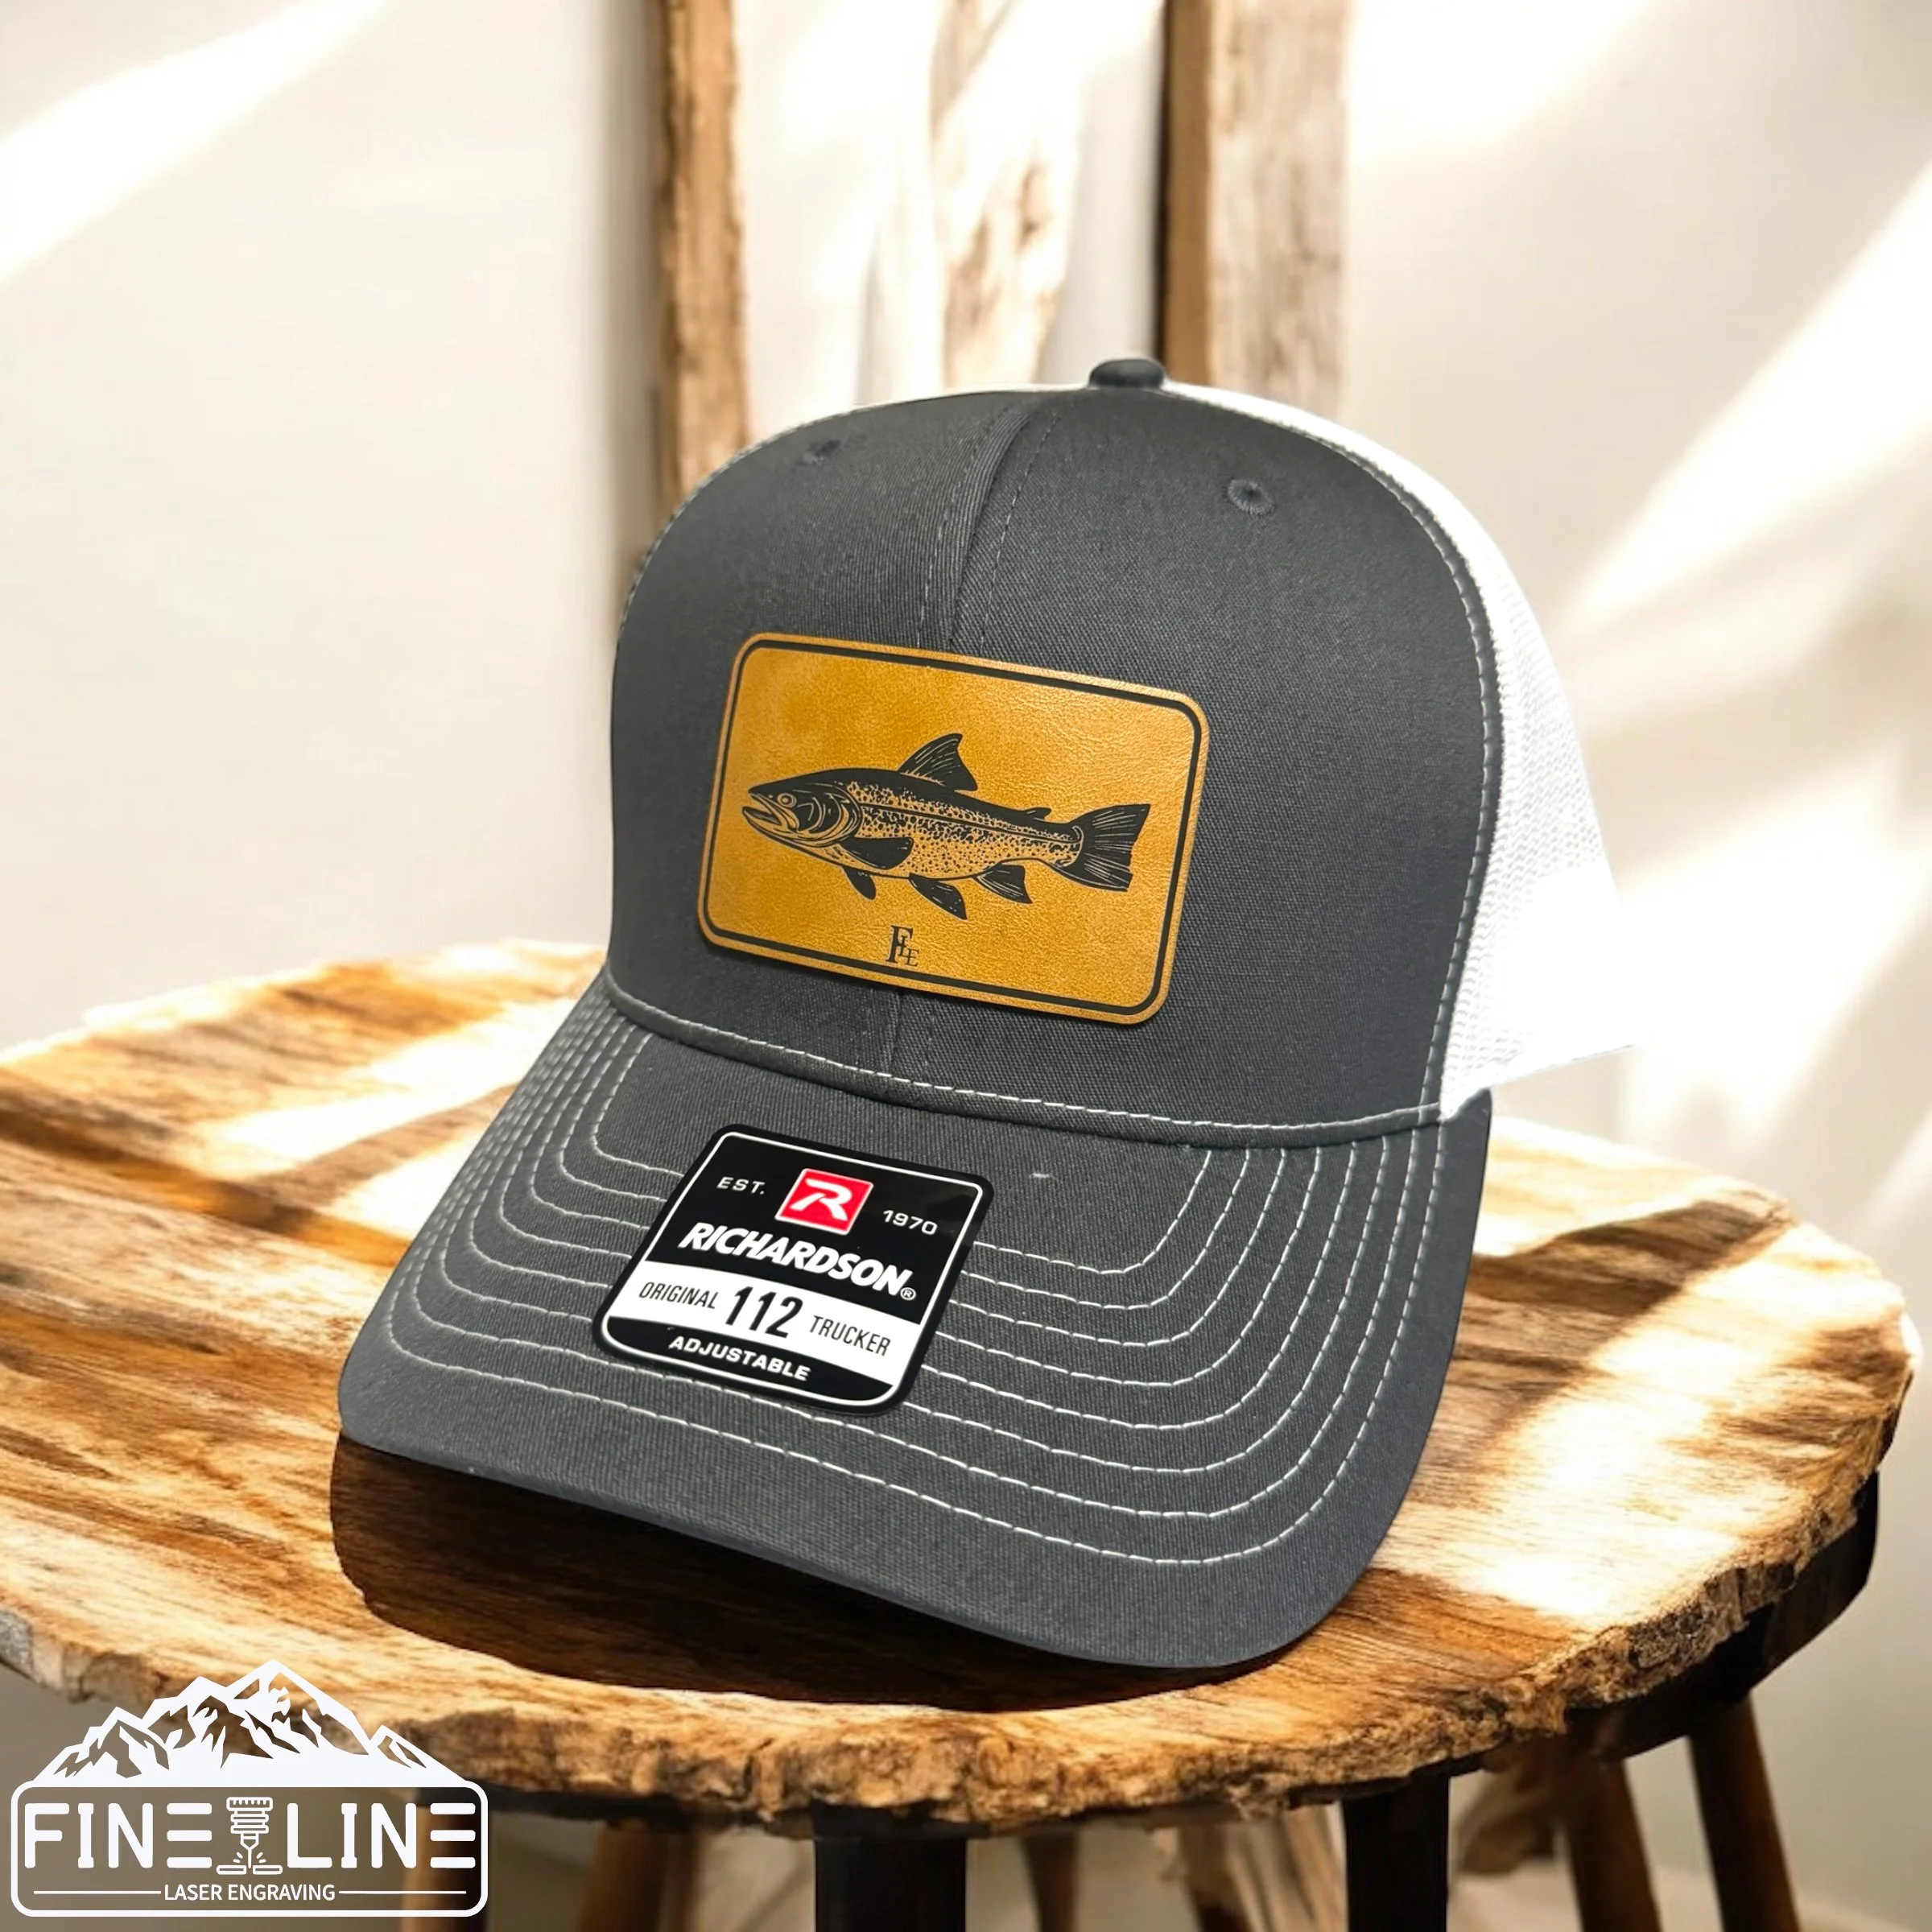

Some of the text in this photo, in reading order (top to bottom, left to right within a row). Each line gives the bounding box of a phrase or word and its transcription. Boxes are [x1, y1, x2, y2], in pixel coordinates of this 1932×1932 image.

[716, 1176, 766, 1195] EST.
[882, 1209, 939, 1236] 1970
[638, 1282, 892, 1357] ORIGINAL 112 TRUCKER
[669, 1335, 811, 1381] ADJUSTABLE
